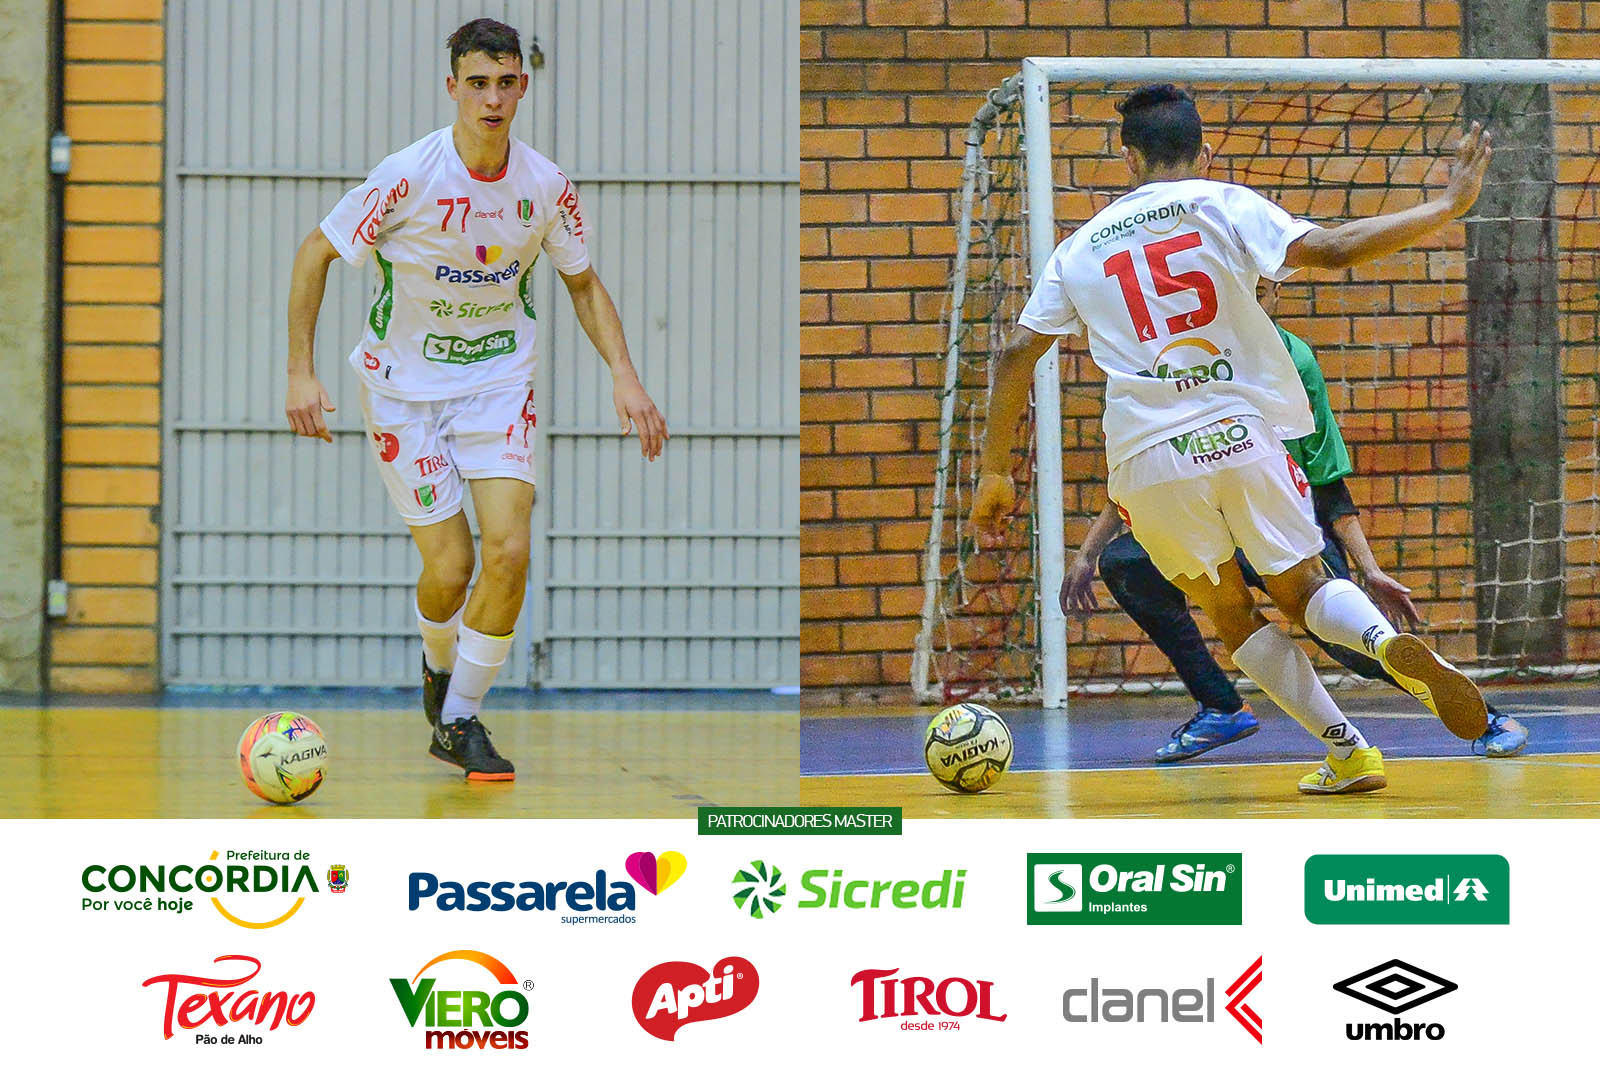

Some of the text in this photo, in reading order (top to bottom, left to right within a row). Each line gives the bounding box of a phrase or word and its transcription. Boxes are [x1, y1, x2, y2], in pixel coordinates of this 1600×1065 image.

[437, 197, 471, 233] 77
[1103, 231, 1219, 343] 15
[485, 335, 510, 350] Sin
[281, 744, 328, 766] KAGIVA
[940, 737, 998, 768] KAGIVA
